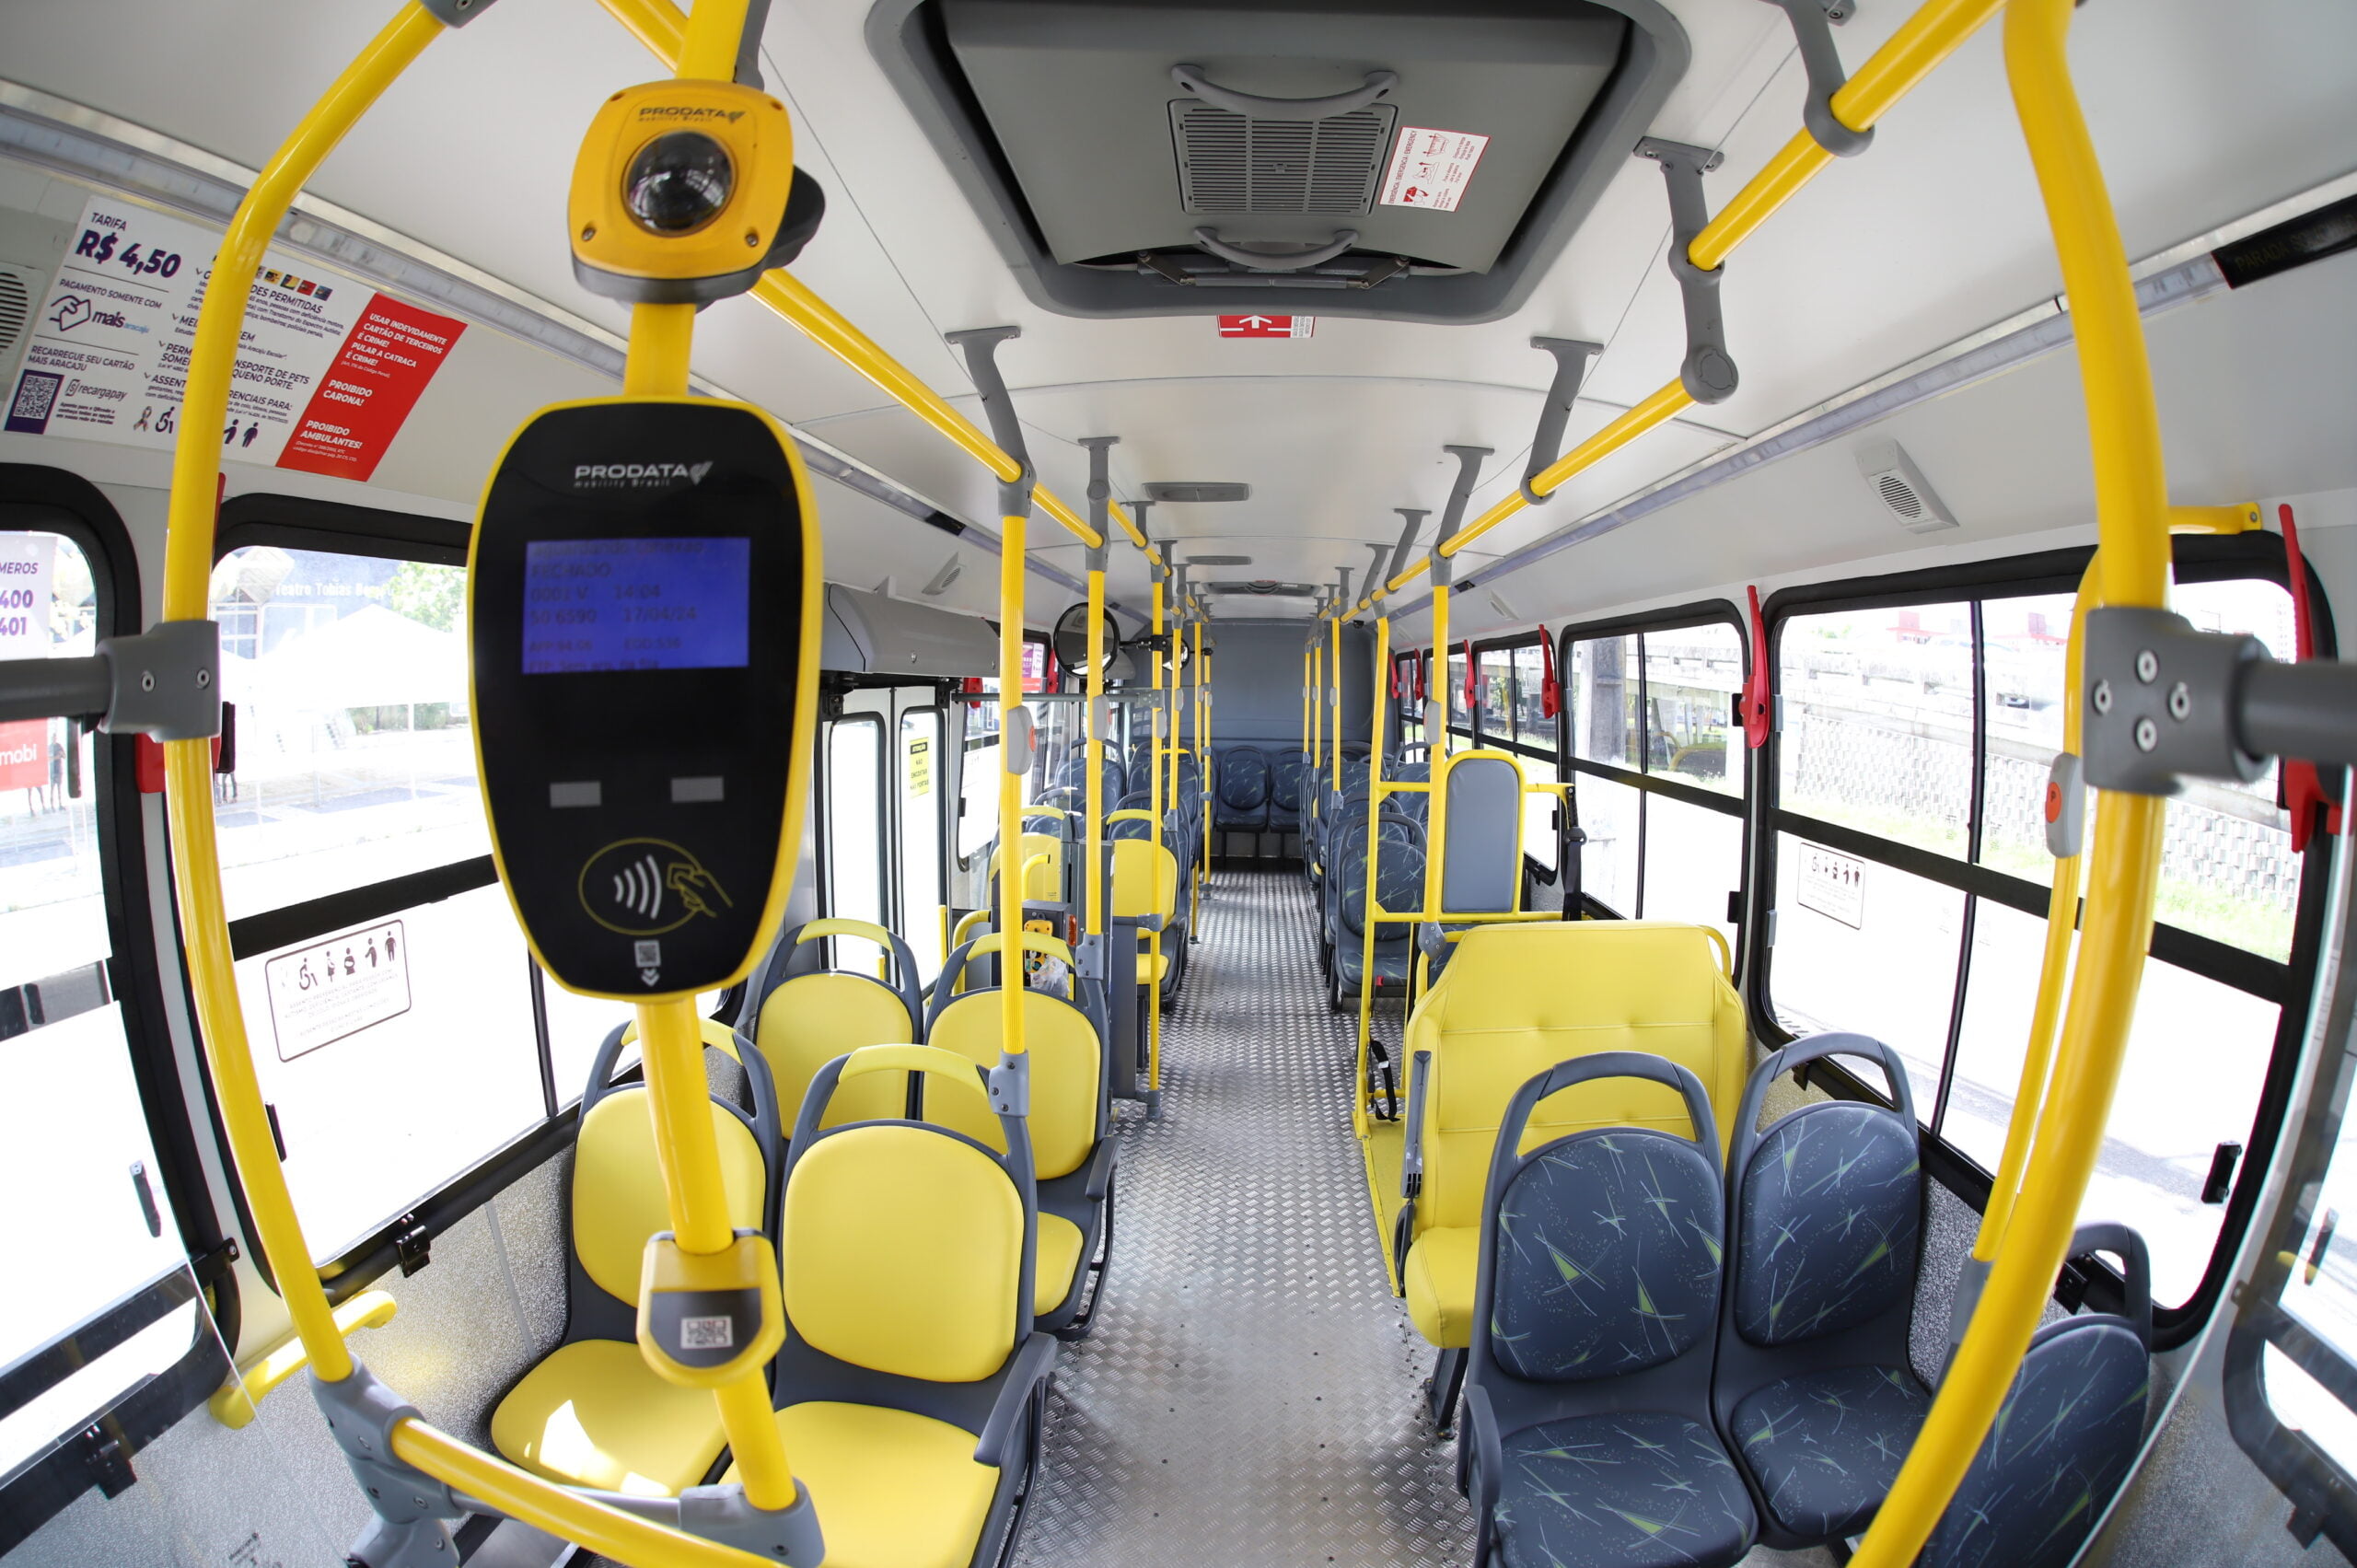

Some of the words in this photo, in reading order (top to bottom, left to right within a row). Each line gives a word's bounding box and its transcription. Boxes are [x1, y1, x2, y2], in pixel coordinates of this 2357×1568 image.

[639, 107, 726, 118] PRODATA
[91, 213, 127, 231] TARIFA
[75, 232, 118, 264] R$
[119, 243, 181, 278] 4,50
[59, 279, 107, 296] PAGAMENTO
[109, 290, 144, 305] SOMENTE
[144, 298, 162, 309] COM
[269, 290, 323, 313] PERMITIDAS
[92, 311, 125, 328] mais
[364, 322, 394, 337] CARTÃO
[394, 332, 406, 342] DE
[405, 337, 444, 354] TERCEIROS
[369, 313, 390, 325] USAR
[390, 320, 447, 345] INDEVIDAMENTE
[357, 331, 365, 340] É
[364, 334, 390, 348] CRIME!
[28, 354, 48, 366] MAIS
[49, 359, 87, 371] ARACAJU
[31, 345, 85, 362] RECARREGUE
[86, 355, 102, 365] SEU
[102, 356, 134, 370] CARTÃO
[345, 350, 353, 358] É
[353, 354, 378, 366] CRIME!
[351, 342, 377, 354] PULAR
[384, 353, 417, 367] CATRACA
[232, 368, 263, 383] QUENO
[264, 376, 294, 390] PORTE.
[234, 359, 275, 376] NSPORTE
[275, 369, 289, 379] DE
[288, 372, 310, 385] PETS
[78, 385, 128, 401] recargapay
[151, 375, 187, 388] ASSENT
[229, 389, 267, 405] RENCIAIS
[267, 398, 293, 411] PARA:
[328, 379, 373, 397] PROIBIDO
[323, 390, 365, 407] CARONA!
[306, 420, 350, 436] PROIBIDO
[300, 430, 363, 449] AMBULANTES!
[575, 464, 689, 479] PRODATA
[2049, 790, 2057, 803] P
